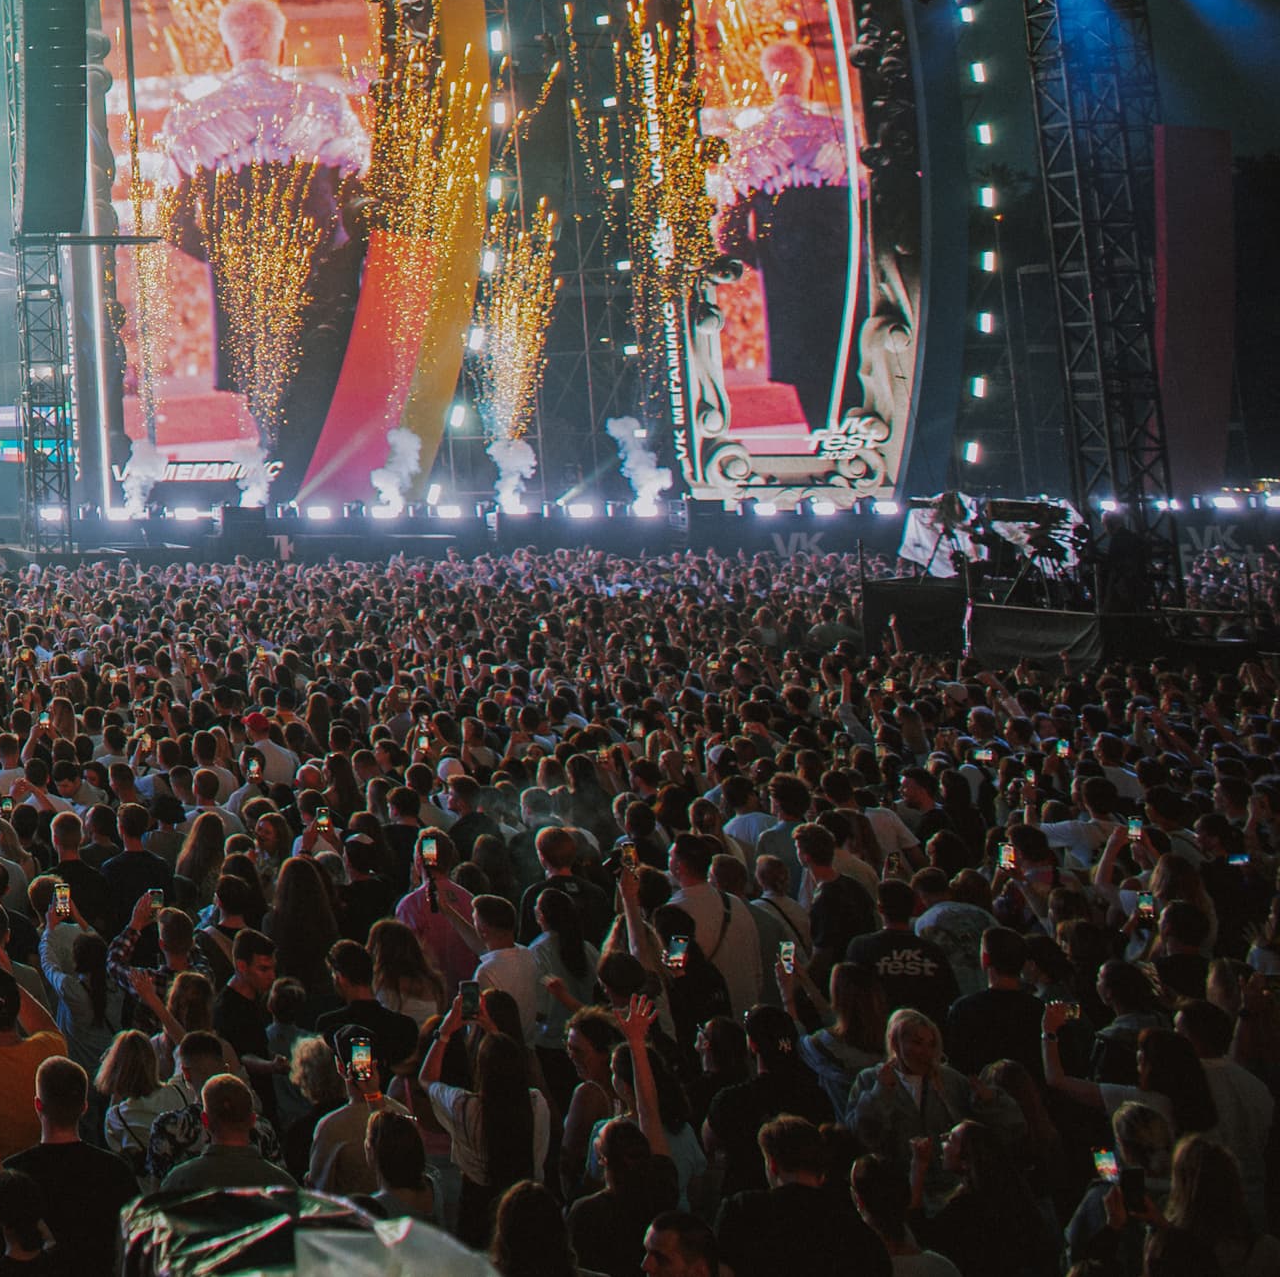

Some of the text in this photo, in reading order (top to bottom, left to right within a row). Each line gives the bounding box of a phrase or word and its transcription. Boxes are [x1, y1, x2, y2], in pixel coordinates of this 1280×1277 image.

[663, 302, 688, 461] VK МЕГАМИКС
[892, 949, 923, 962] VK
[875, 956, 939, 976] fest
